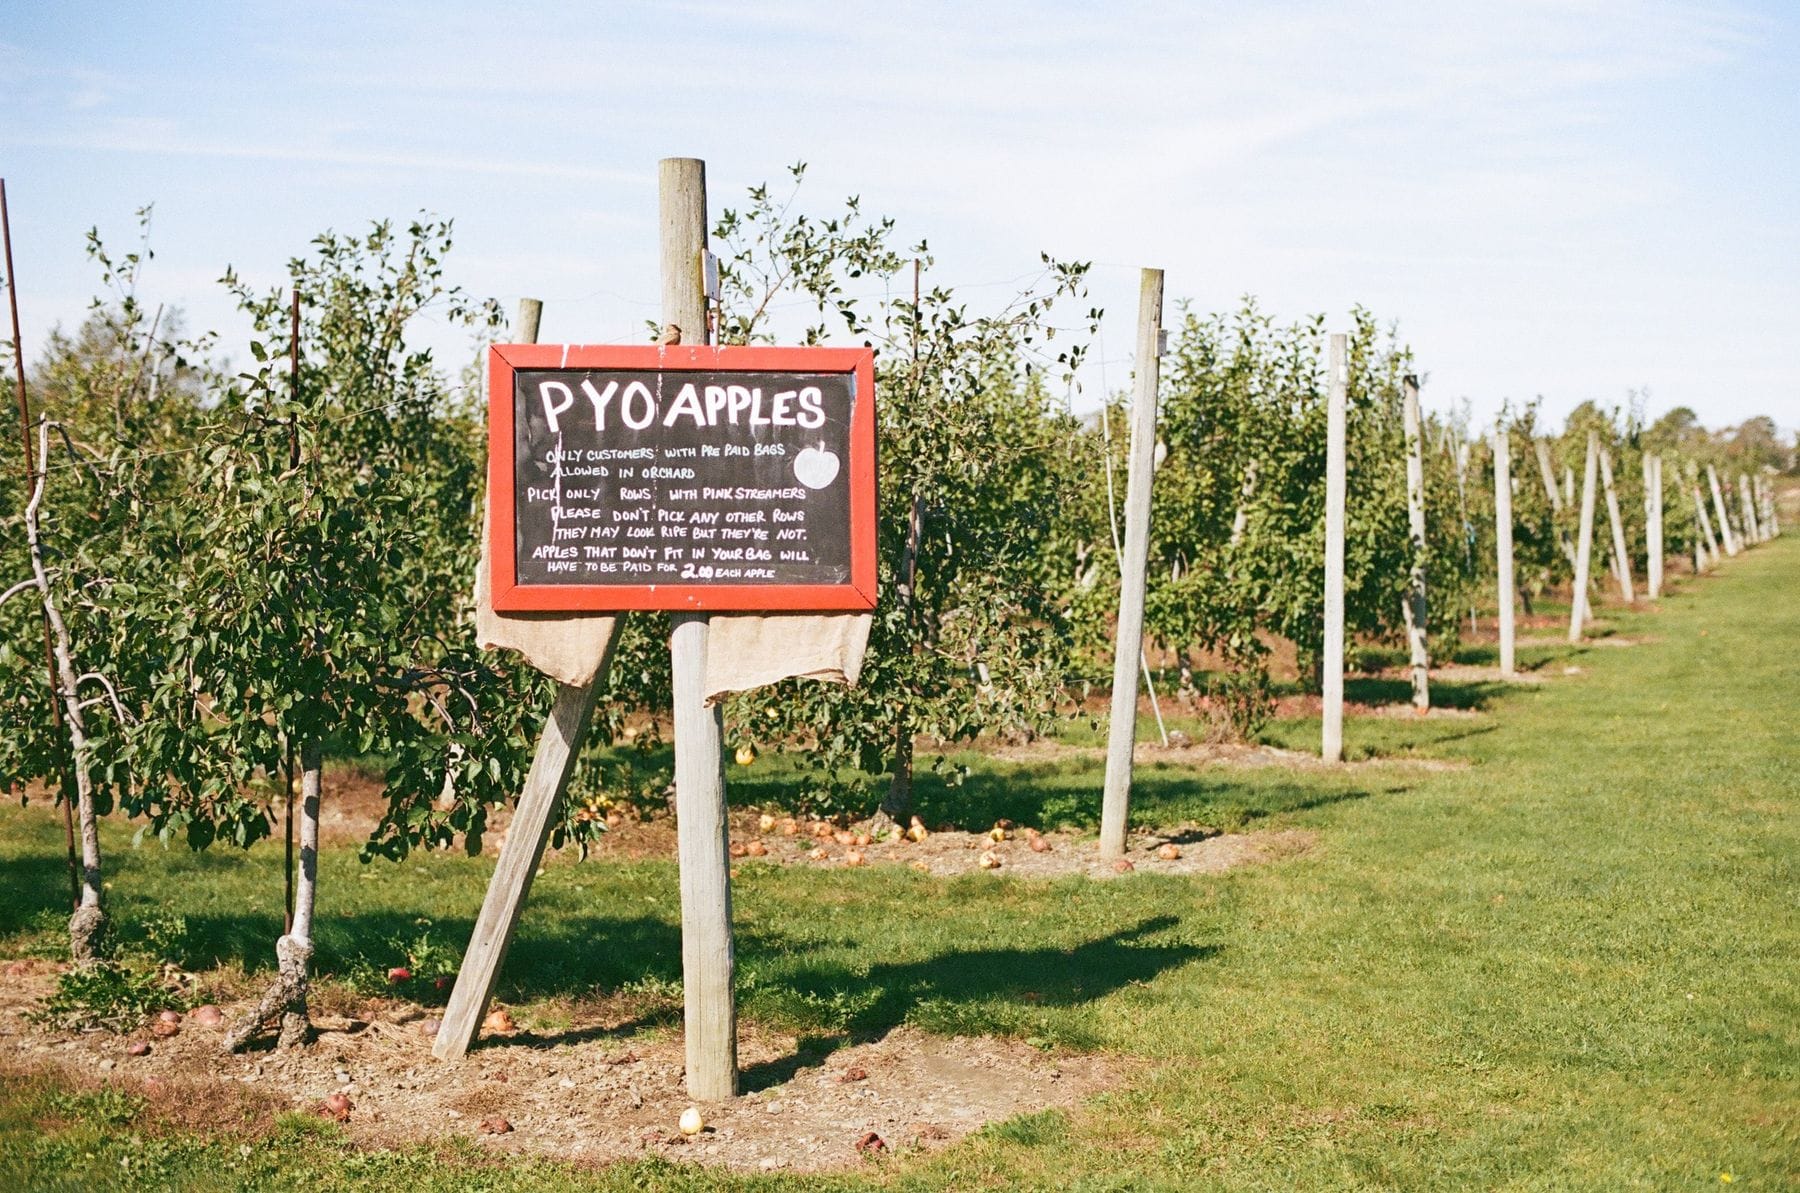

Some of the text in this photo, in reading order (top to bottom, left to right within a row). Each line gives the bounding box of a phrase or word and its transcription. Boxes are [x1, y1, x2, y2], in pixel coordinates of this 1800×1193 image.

[539, 379, 826, 433] PYO APPLES
[546, 443, 786, 463] ONLY CUSTOMERS WITH PRE PAID BAGS
[550, 465, 695, 479] ALLOWED IN ORCHARD
[527, 487, 806, 502] PICK ONLY ROWS WITH PINK STREAMERS
[551, 506, 805, 524] PLEASE DON'T PICK ANY OTHER ROWS
[555, 526, 807, 540] THEY MAY LOOK RIPE BUT THEY'RE NOT.
[532, 545, 810, 561] APPLES THAT DON'T FIT IN YOUR BAG WILL
[547, 562, 776, 579] HAVE TO BE PAID FOR 2.00 EACH APPLE
